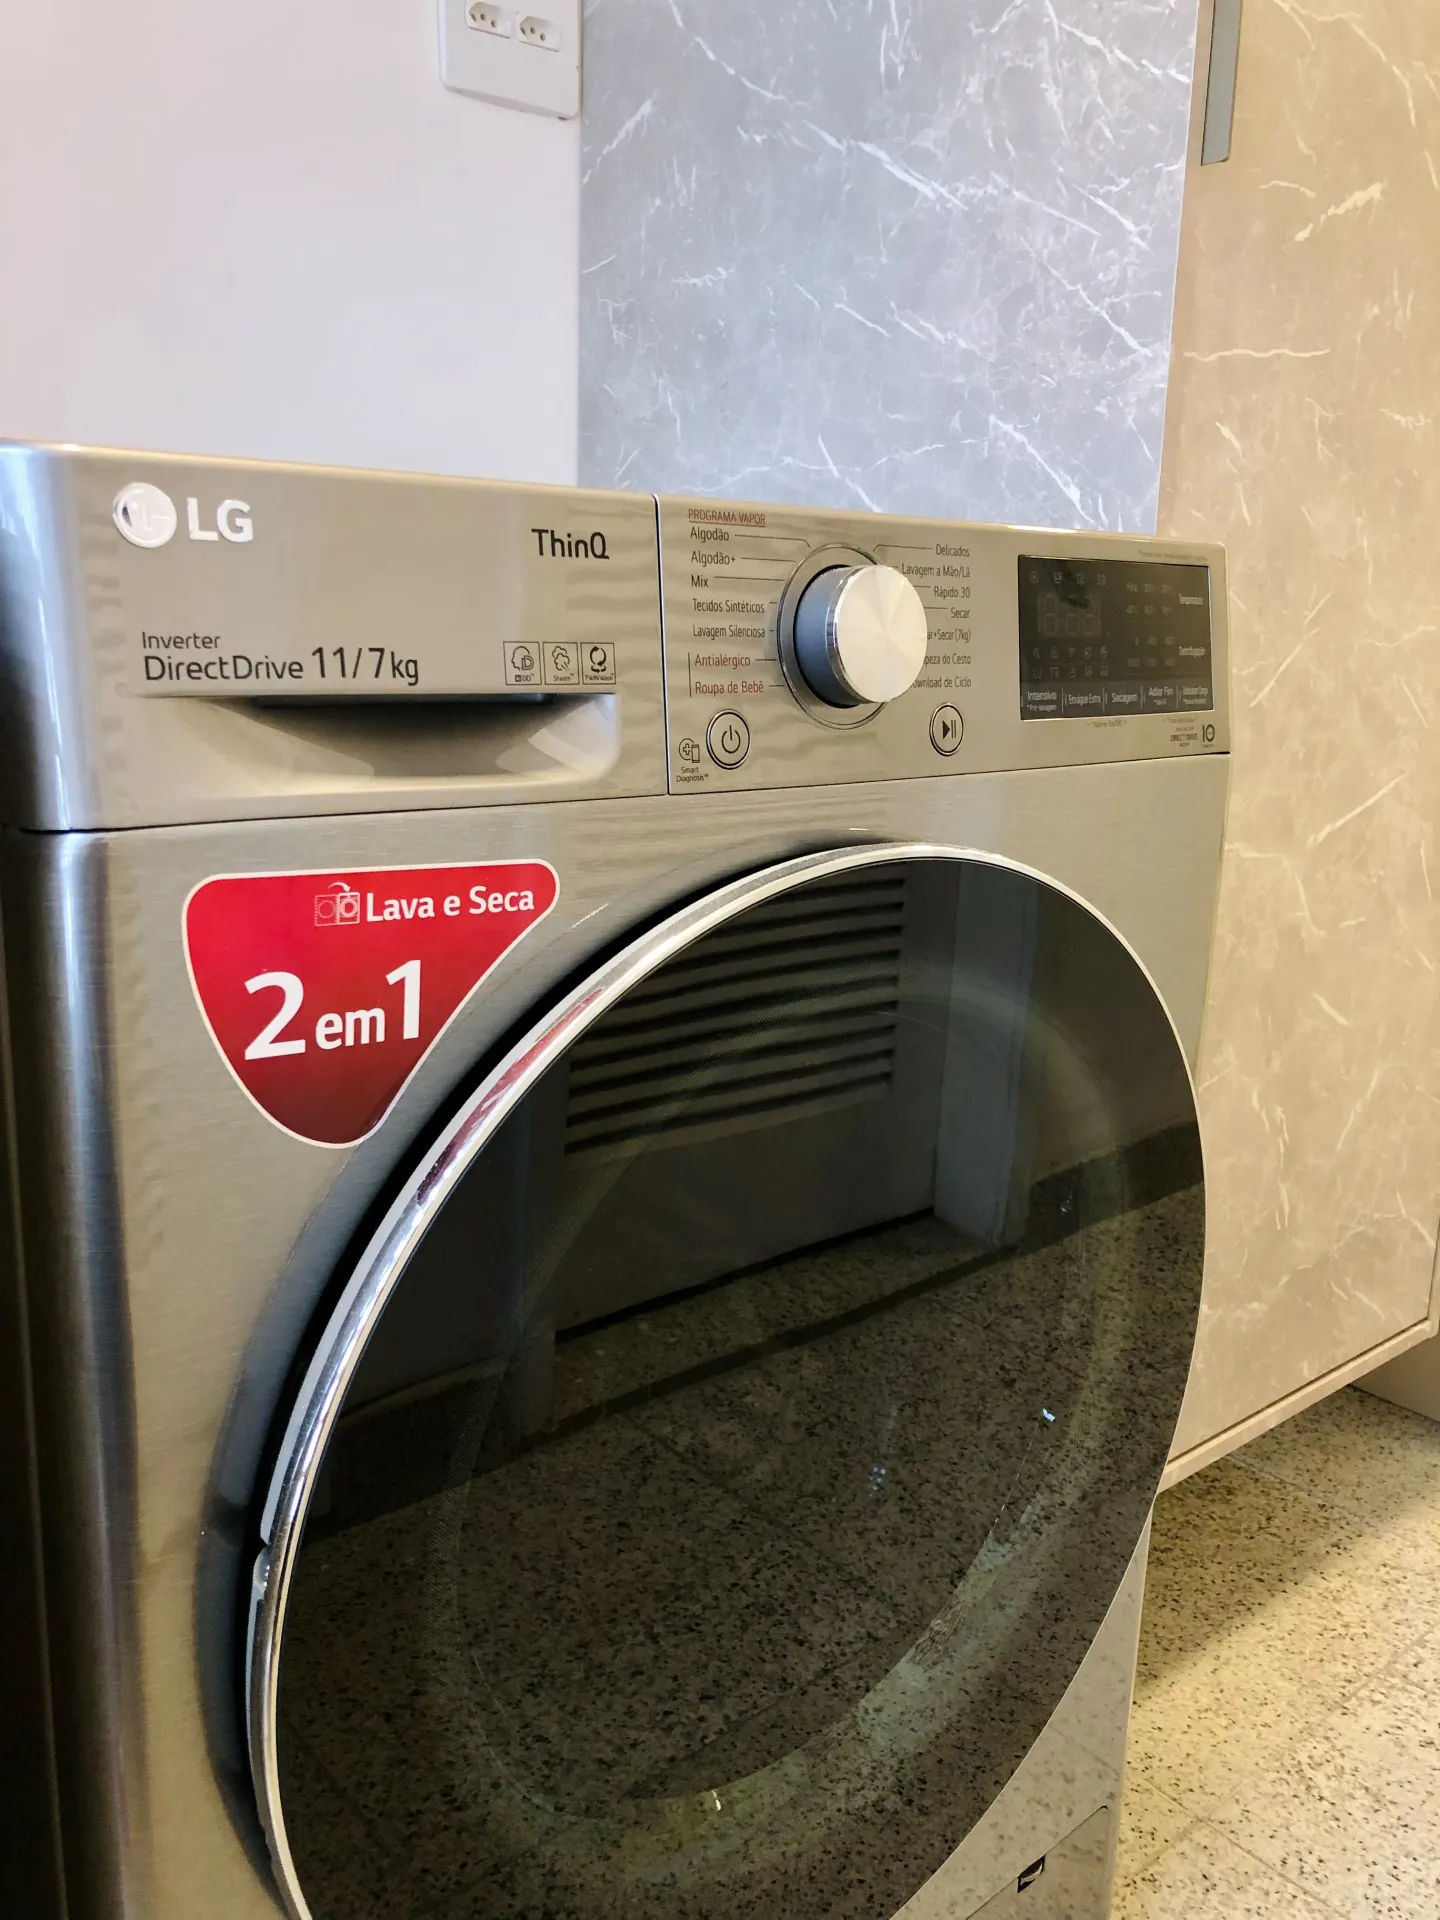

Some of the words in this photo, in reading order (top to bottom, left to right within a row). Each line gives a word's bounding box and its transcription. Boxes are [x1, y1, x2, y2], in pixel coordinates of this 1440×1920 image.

[186, 497, 254, 543] LG
[688, 508, 737, 522] PROGRAMA
[739, 512, 766, 525] VAPOR
[690, 526, 730, 543] Algodão
[531, 528, 610, 560] ThinQ
[935, 543, 970, 557] Delicados
[691, 550, 736, 567] Algodão+
[901, 563, 935, 578] Lavagem
[936, 567, 941, 576] a
[942, 565, 971, 578] Mão/Lã
[691, 574, 709, 588] Mix
[933, 585, 959, 599] Rápido
[960, 586, 971, 598] 30
[692, 598, 723, 612] Tecidos
[725, 600, 765, 613] Sintéticos
[950, 607, 970, 619] Secar
[693, 624, 727, 640] Lavagem
[728, 624, 766, 638] Silenciosa
[142, 632, 221, 649] Inverter
[694, 654, 751, 669] Antialérgico
[942, 652, 951, 665] do
[952, 652, 972, 665] Cesto
[695, 681, 725, 696] Roupa
[727, 681, 738, 693] de
[741, 680, 764, 693] Bebê
[912, 676, 942, 688] ownload
[944, 676, 953, 688] de
[954, 676, 972, 688] Ciclo
[1027, 690, 1057, 701] Intensivo
[366, 891, 435, 923] Lava
[443, 895, 461, 917] e
[469, 885, 535, 915] Seca
[244, 971, 306, 1061] 2
[315, 1005, 386, 1051] em
[385, 959, 421, 1040] 1
